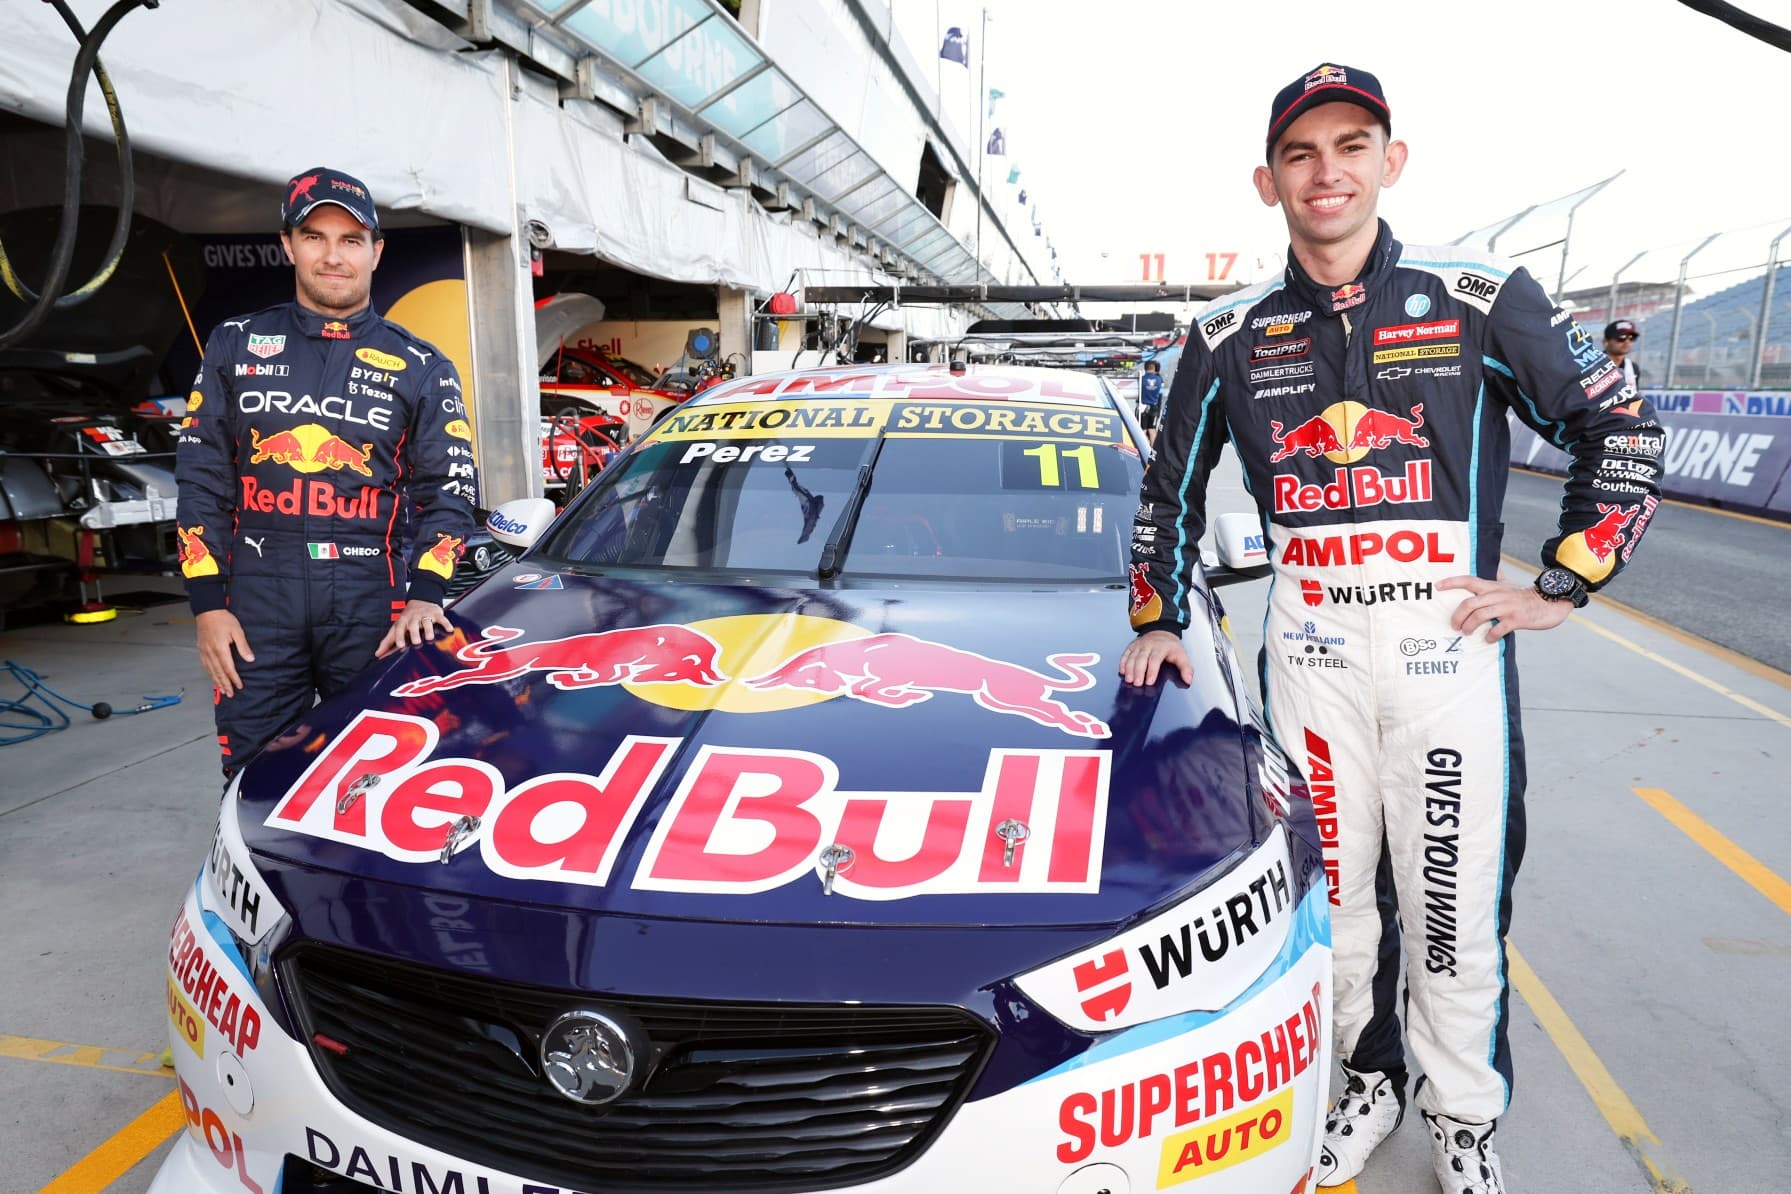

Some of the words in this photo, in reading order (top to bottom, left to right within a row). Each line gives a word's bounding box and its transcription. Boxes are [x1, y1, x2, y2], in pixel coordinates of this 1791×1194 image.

[1305, 75, 1325, 93] Red
[1326, 73, 1347, 84] Bull
[204, 244, 255, 267] GIVES
[1139, 253, 1165, 281] 11
[1205, 252, 1238, 281] 17
[1457, 276, 1497, 297] OMP
[1332, 299, 1350, 312] Red
[1350, 292, 1366, 306] Bull
[1409, 294, 1427, 317] hp
[1205, 312, 1235, 336] OMP
[1251, 311, 1312, 329] SUPERCHEAP
[1268, 325, 1290, 334] AUTO
[256, 336, 282, 344] TAG
[321, 329, 336, 338] Red
[336, 330, 350, 339] Bull
[1378, 329, 1415, 341] Harvey
[1416, 324, 1458, 336] Norman
[578, 338, 621, 355] Shell
[1254, 341, 1307, 358] ToolPRO
[1375, 349, 1417, 361] NATIONAL
[1418, 346, 1458, 356] STORAGE
[235, 364, 274, 377] Mobil
[369, 353, 400, 368] RAUCH
[1415, 365, 1462, 374] CHEVROLET
[351, 367, 399, 388] BYBIT
[712, 373, 1097, 401] AMPOL
[360, 385, 393, 401] Tezos
[1263, 383, 1316, 398] AMPLIFY
[239, 390, 393, 431] ORACLE
[662, 407, 875, 434] NATIONAL
[898, 406, 1112, 437] STORAGE
[1604, 432, 1666, 450] central
[680, 442, 816, 464] Perez
[1023, 443, 1100, 489] 11
[1273, 466, 1350, 513] Red
[1351, 458, 1432, 508] Bull
[240, 475, 303, 515] Red
[307, 481, 381, 520] Bull
[1621, 526, 1642, 564] Red
[1635, 494, 1660, 533] Bull
[342, 546, 380, 557] CHECO
[1281, 530, 1455, 567] AMPOL
[1328, 582, 1433, 606] WÜRTH
[1283, 631, 1304, 641] NEW
[1305, 633, 1345, 646] HOLLAND
[1287, 655, 1304, 666] TW
[1307, 657, 1348, 669] STEEL
[1405, 660, 1459, 675] FEENEY
[1424, 747, 1463, 835] GIVES
[263, 708, 685, 888] Red
[630, 743, 1113, 901] Bull
[1422, 833, 1460, 890] YOU
[1138, 859, 1291, 990] WÜRTH
[1424, 889, 1458, 979] WINGS
[1172, 1108, 1283, 1175] AUTO
[306, 1125, 588, 1194] DAIM
